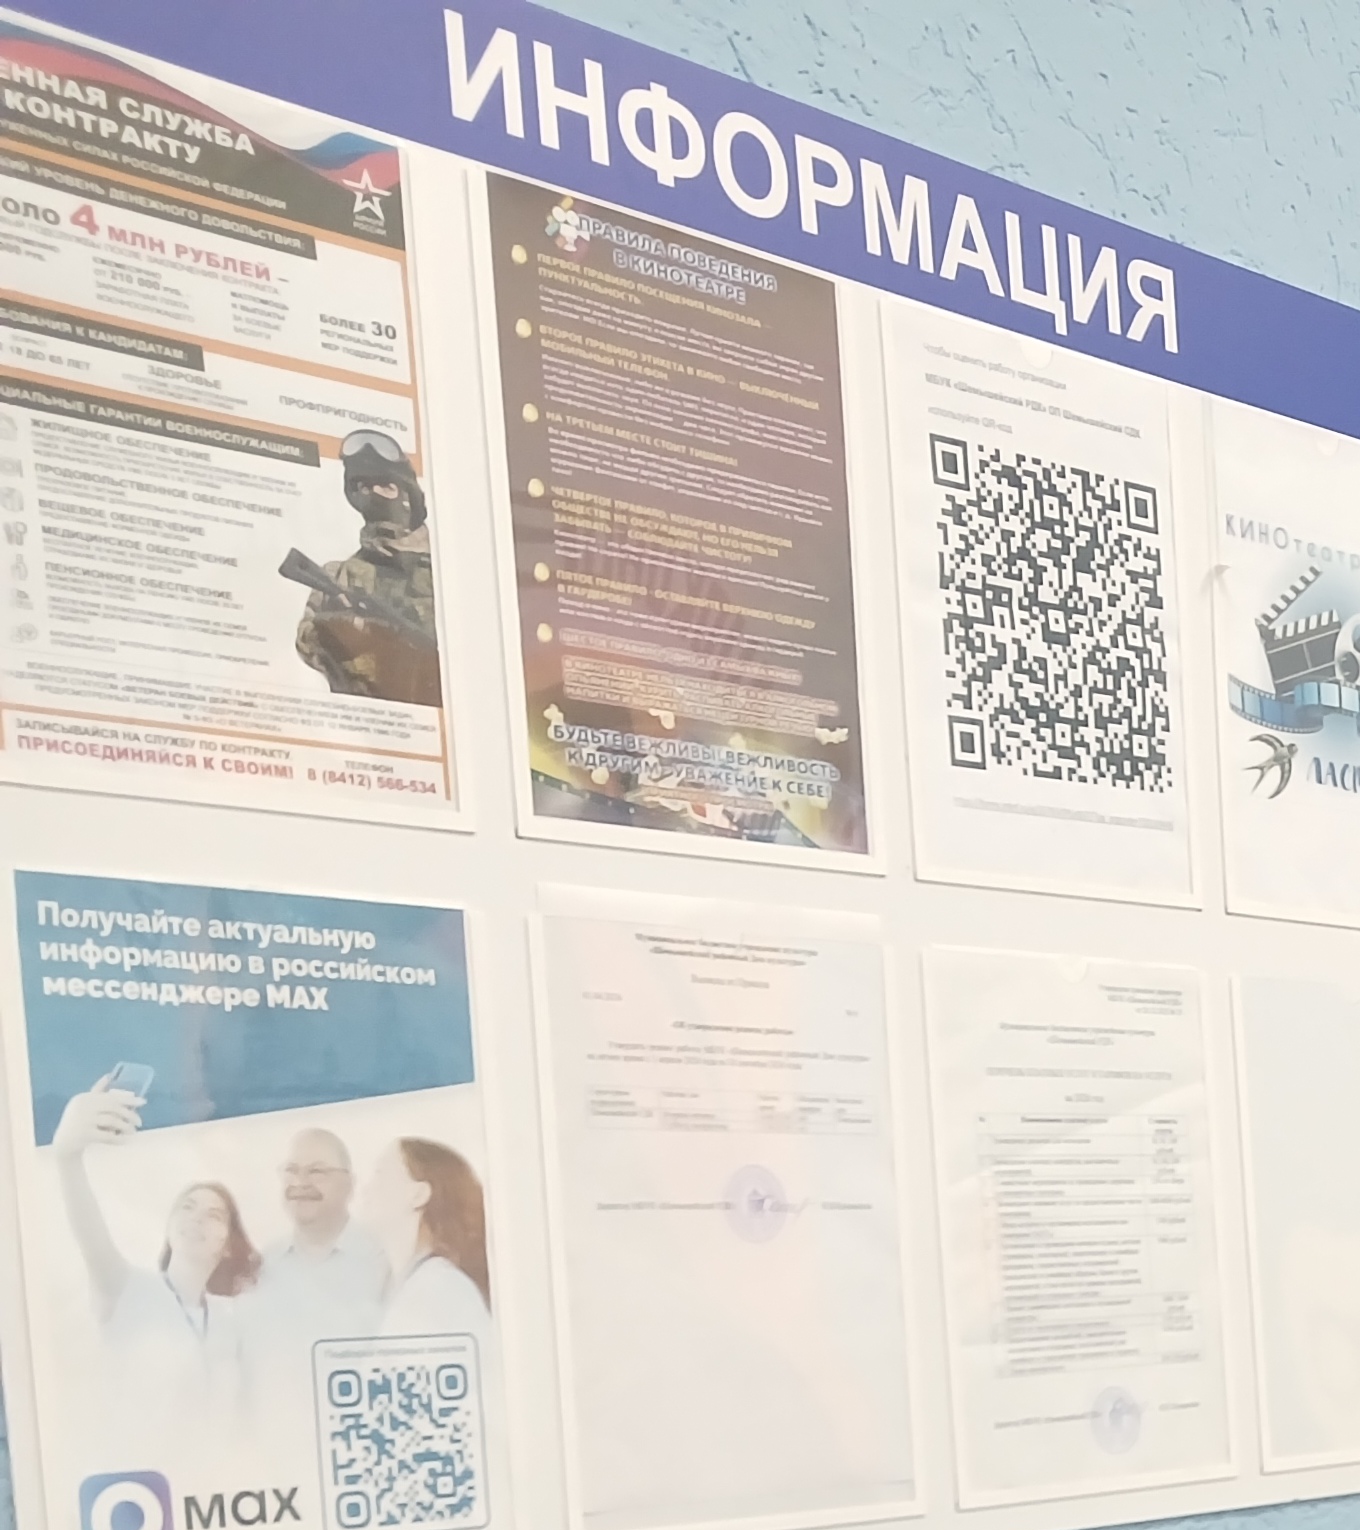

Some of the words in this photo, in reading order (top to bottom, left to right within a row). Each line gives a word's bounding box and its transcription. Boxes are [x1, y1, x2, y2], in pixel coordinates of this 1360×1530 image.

[4, 88, 201, 164] КОНТРАКТУ
[119, 97, 256, 156] СЛУЖБА
[34, 165, 106, 195] УРОВЕНЬ
[109, 187, 199, 221] ДЕНЕЖНОГО
[121, 154, 210, 189] РОССИЙСКОЙ
[212, 181, 287, 210] ФЕДЕРАЦИИ
[443, 8, 1181, 356] ИНФОРМАЦИЯ
[70, 204, 101, 236] 4
[107, 225, 166, 255] МЛН
[175, 243, 271, 281] РУБЛЕЙ
[577, 213, 665, 257] ПРАВИЛА
[668, 242, 778, 292] ПОВЕДЕНИЯ
[613, 249, 629, 269] В
[629, 254, 747, 305] КИНОТЕАТРЕ
[319, 313, 366, 333] БОЛЕЕ
[371, 320, 397, 340] 30
[90, 405, 163, 428] ГАРАНТИИ
[16, 717, 118, 740] ЗАПИСЫВАЙСЯ
[122, 731, 141, 742] НА
[144, 733, 196, 748] СЛУЖБУ
[199, 740, 218, 751] ПО
[17, 735, 197, 769] ПРИСОЕДИНЯЙСЯ
[203, 756, 215, 771] К
[221, 760, 294, 780] СВОИМ!
[553, 723, 622, 748] БУДЬТЕ
[726, 749, 840, 781] ВЕЖЛИВОСТЬ
[307, 767, 317, 781] 8
[567, 751, 580, 765] К
[584, 749, 660, 776] ДРУГИМ
[673, 764, 768, 791] УВАЖЕНИЕ
[771, 779, 783, 792] К
[37, 900, 201, 938] Получайте
[207, 917, 377, 954] актуальную
[39, 938, 242, 974] информацию
[248, 952, 265, 975] в
[271, 957, 437, 986] российском
[42, 974, 261, 1012] мессенджере
